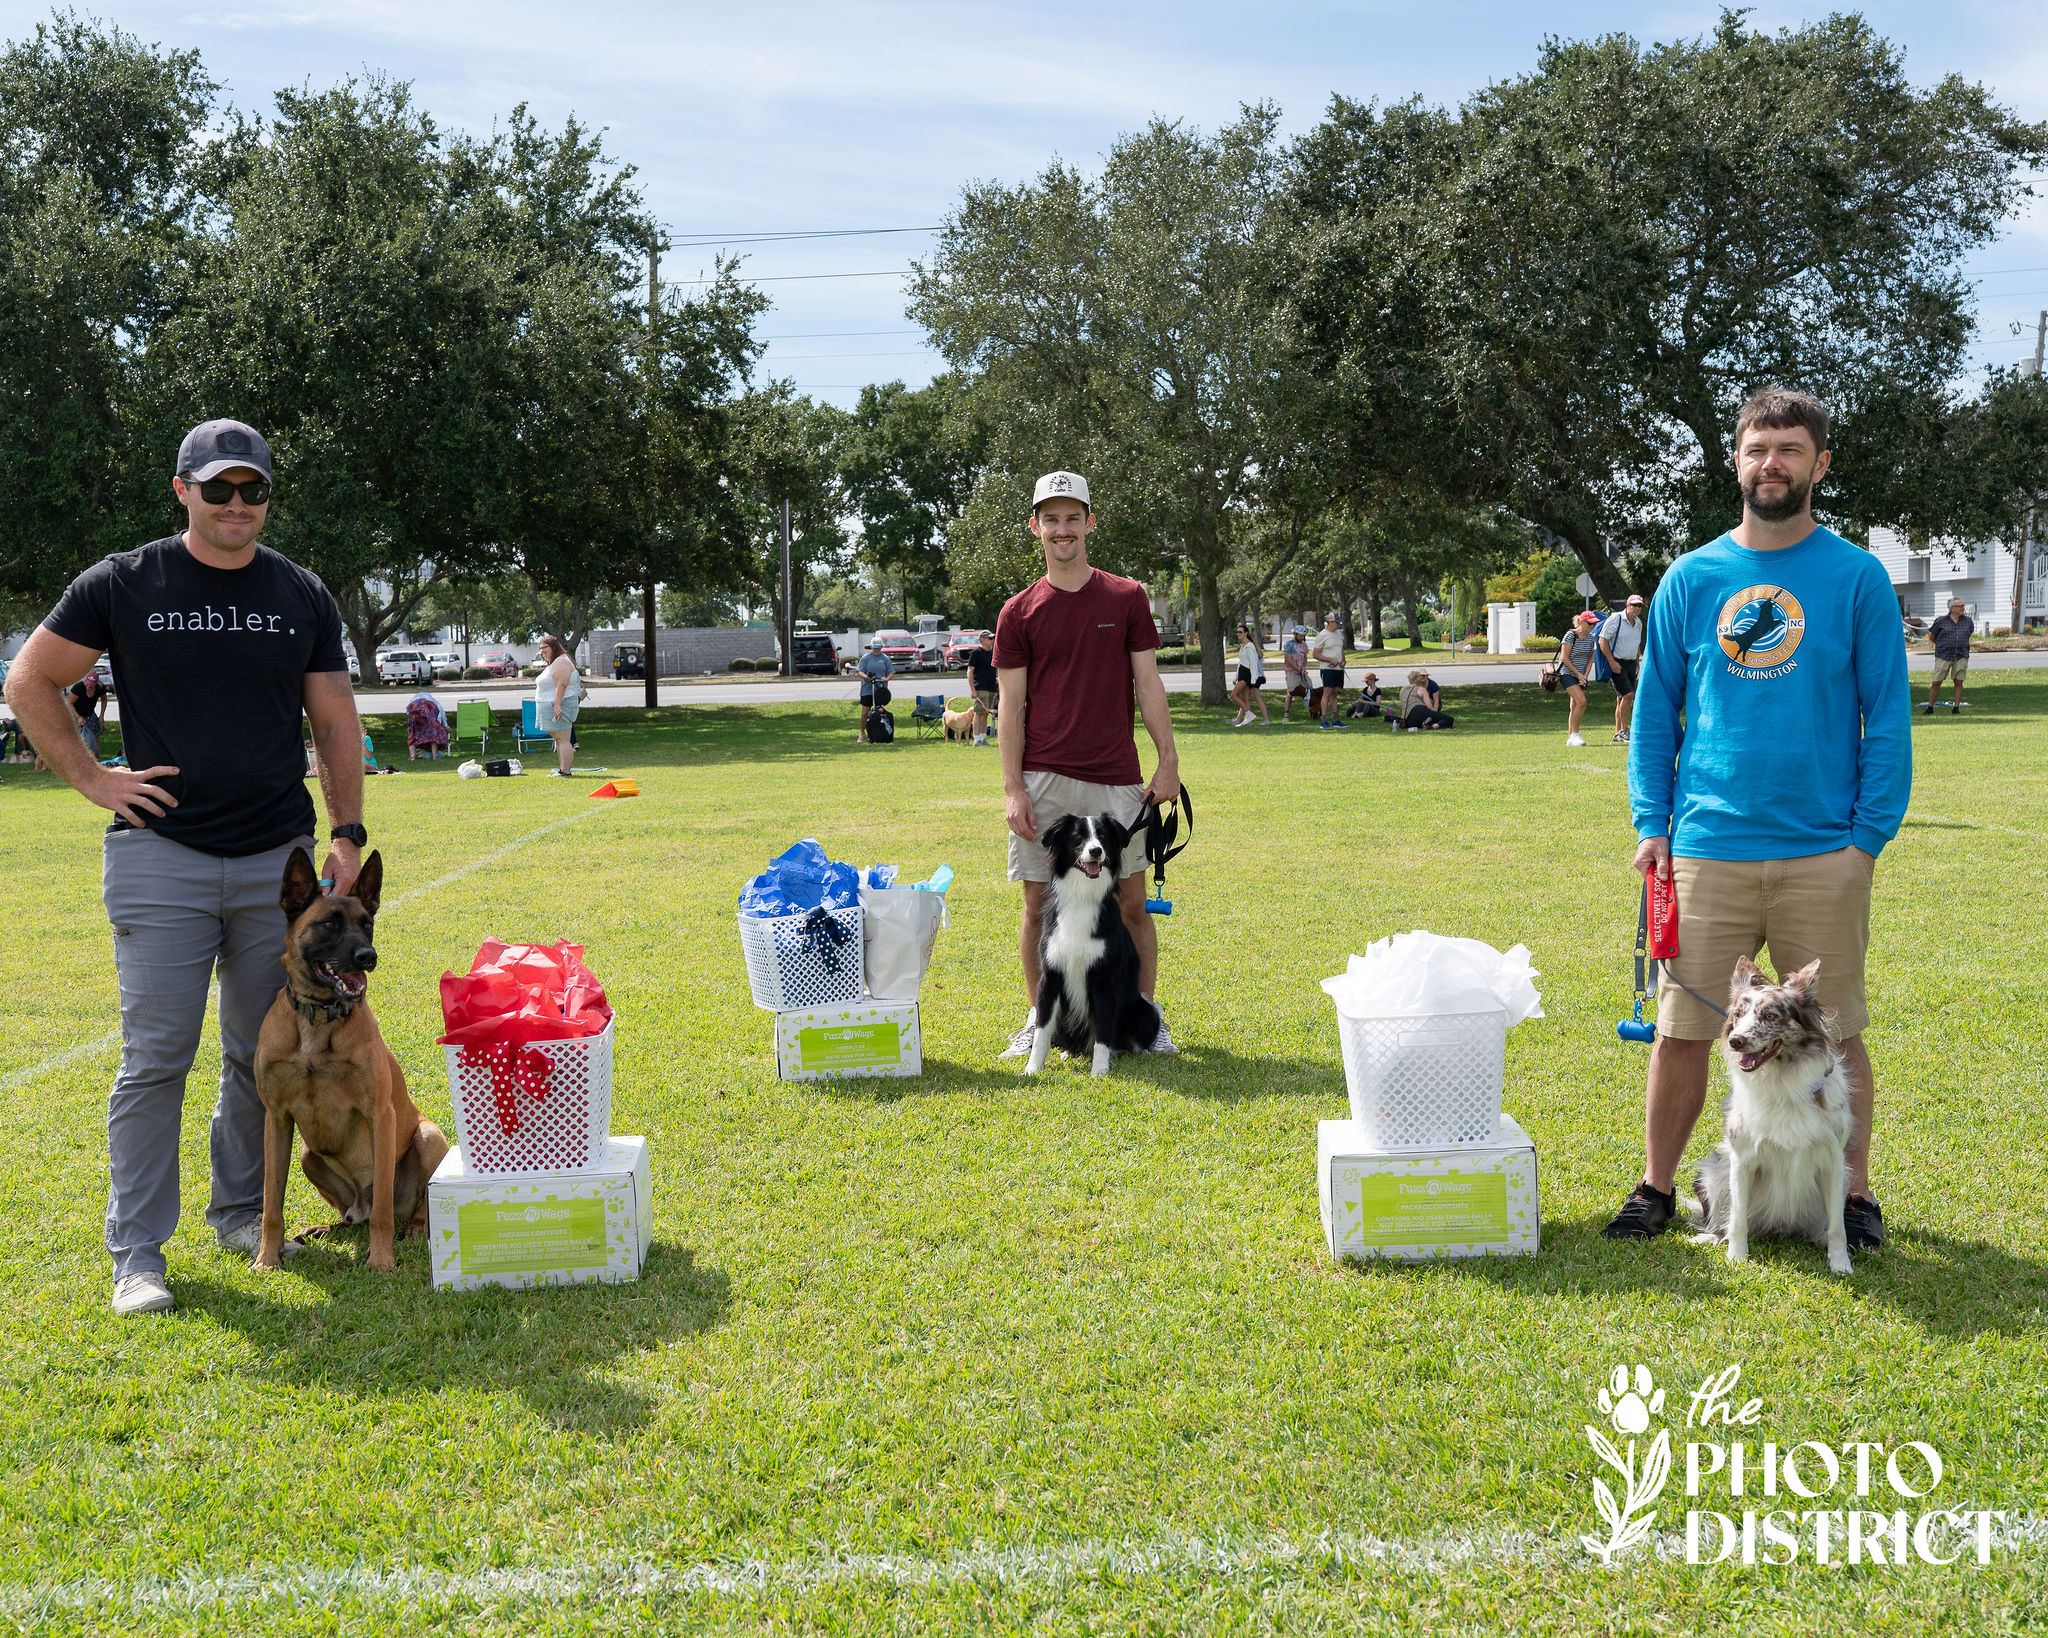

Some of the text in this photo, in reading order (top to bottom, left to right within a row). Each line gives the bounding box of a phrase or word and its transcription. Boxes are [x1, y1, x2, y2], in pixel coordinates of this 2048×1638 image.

[147, 605, 296, 635] enabler.
[1790, 619, 1803, 628] NC
[1747, 656, 1770, 664] TOSS
[1778, 630, 1798, 657] FETCH
[1726, 659, 1798, 680] WILMINGTON
[1653, 892, 1662, 943] SELECTIVELY
[1661, 913, 1668, 923] DO
[1443, 1183, 1473, 1194] Wags
[540, 1208, 571, 1220] Wags
